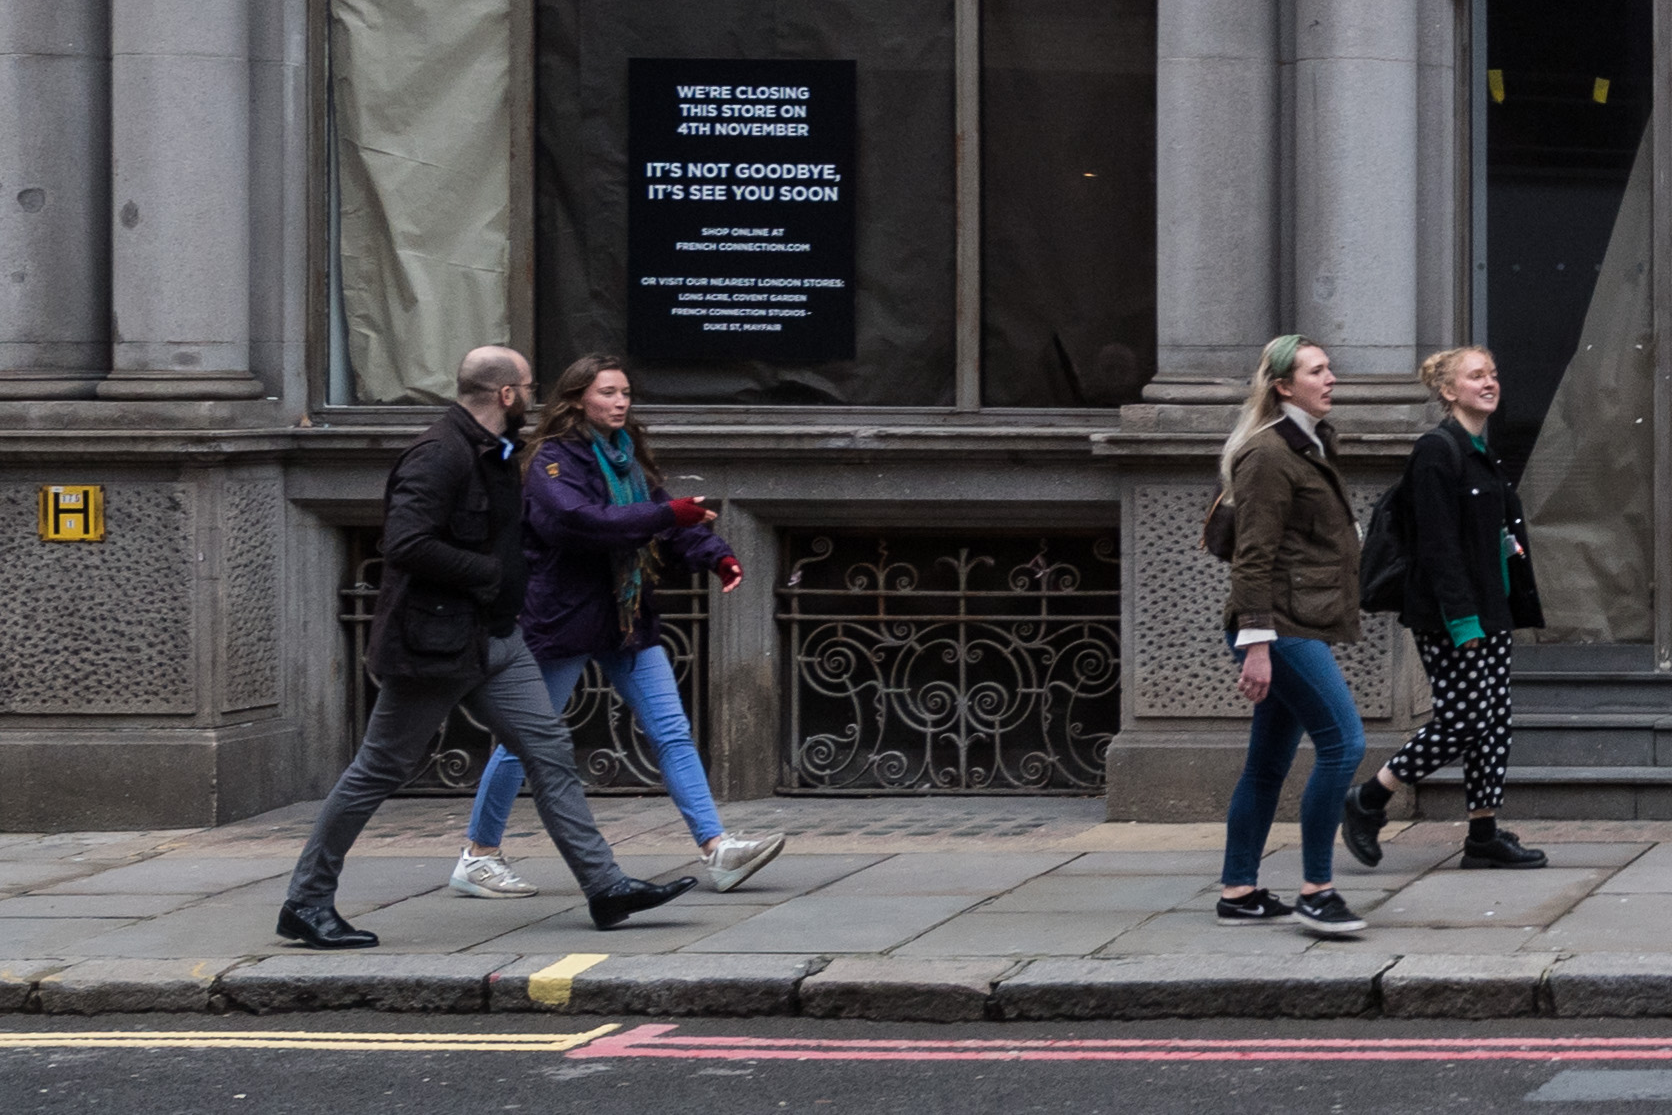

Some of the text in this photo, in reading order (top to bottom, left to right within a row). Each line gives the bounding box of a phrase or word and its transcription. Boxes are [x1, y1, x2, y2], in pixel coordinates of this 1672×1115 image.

[676, 85, 810, 100] WE’RE CLOSING
[679, 104, 807, 118] THIS STORE ON
[677, 122, 809, 136] 4TH NOVEMBER
[646, 162, 841, 182] IT’S NOT GOODBYE,
[648, 184, 838, 201] IT’S SEE YOU SOON
[701, 227, 785, 237] SHOP ONLINE AT
[676, 242, 811, 252] FRENCH CONNECTION.COM
[640, 277, 845, 288] OR VISIT OUR NEAREST LONDON STORES:
[678, 293, 807, 302] LONG ACRE, COVENT GARDEN
[671, 307, 708, 316] FRENCH
[709, 308, 767, 317] CONNECTION
[768, 308, 806, 317] STUDIOS
[703, 323, 782, 332] DUKE ST, MAYFAIR
